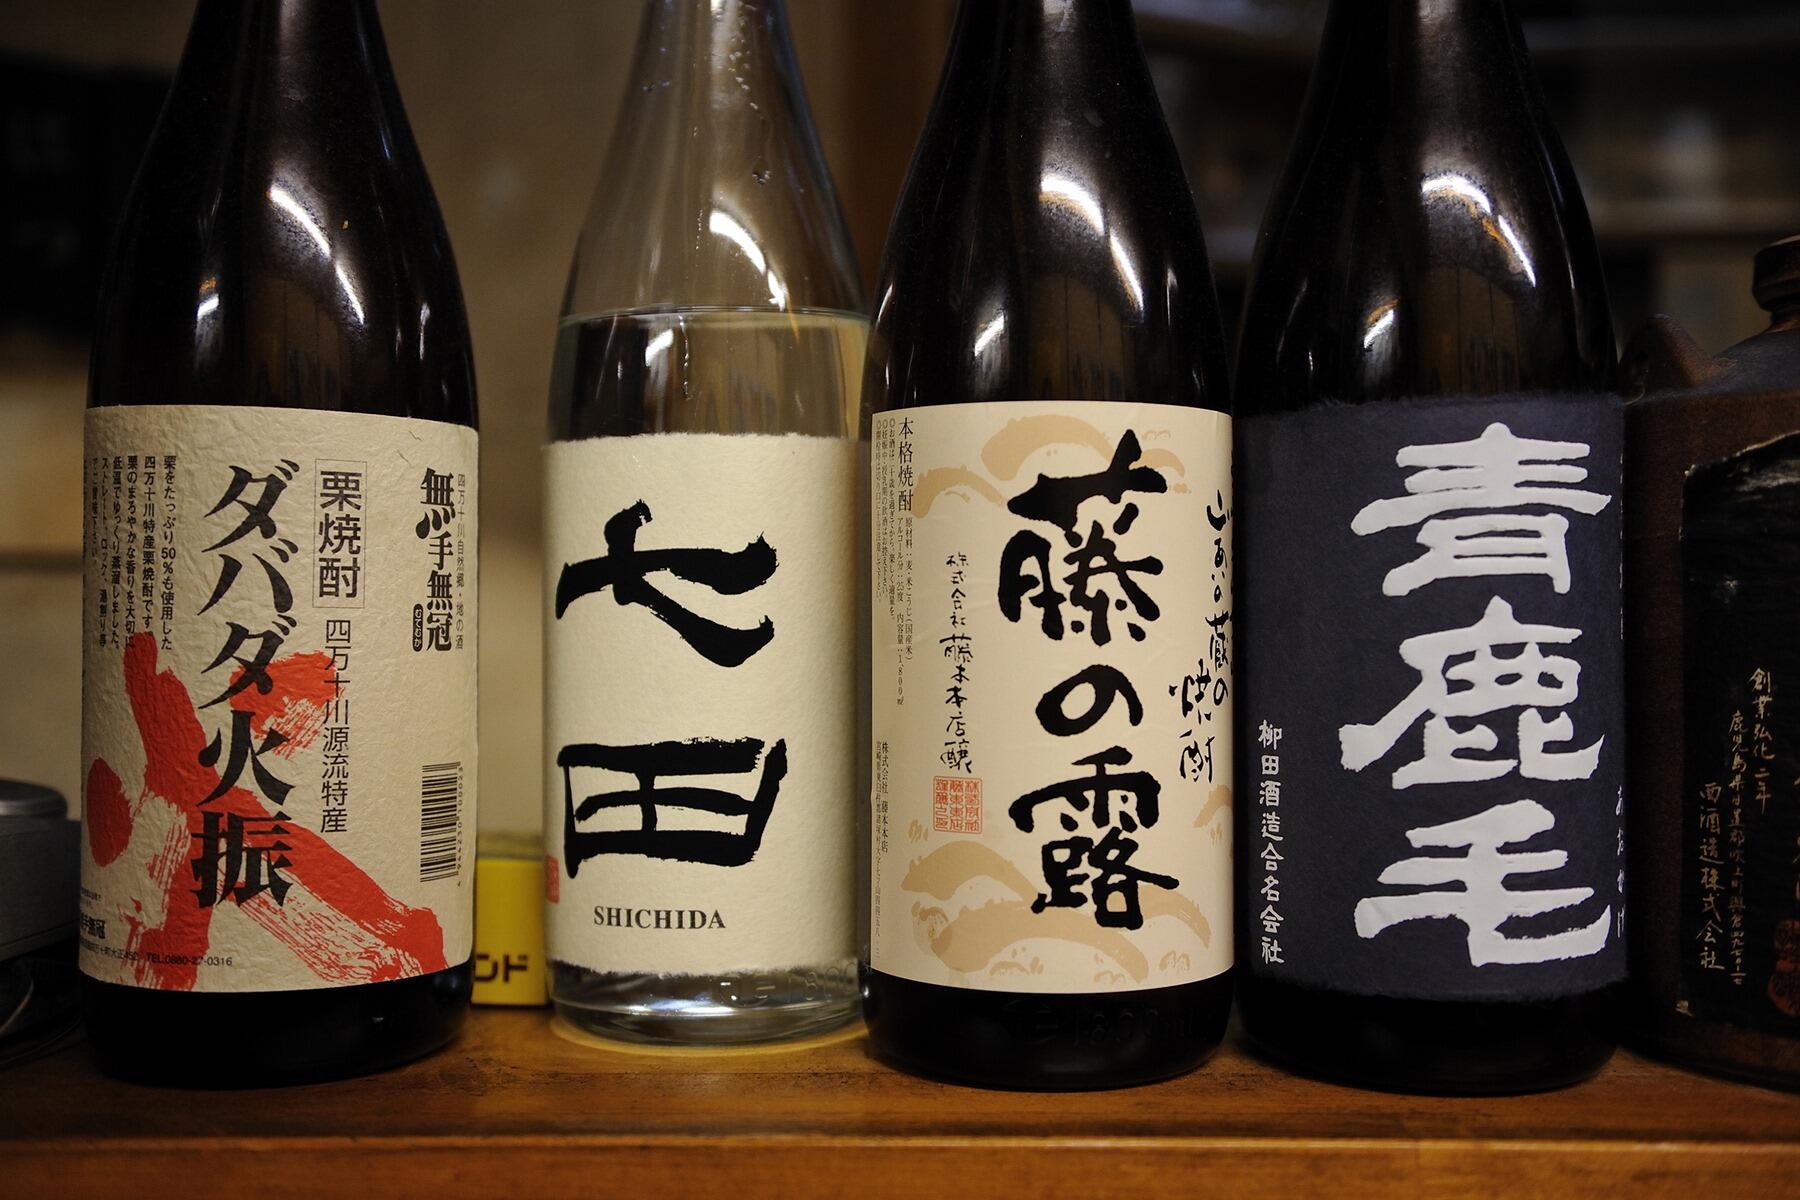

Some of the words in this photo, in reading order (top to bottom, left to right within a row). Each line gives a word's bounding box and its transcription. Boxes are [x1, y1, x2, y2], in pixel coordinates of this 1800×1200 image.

[319, 470, 362, 598] 栗焼酎
[416, 467, 456, 652] 無手無冠
[898, 417, 914, 512] 本格焼酎
[191, 459, 300, 907] ダバダ火振
[320, 619, 352, 834] 四万十川源流特産
[556, 499, 788, 878] 七田
[998, 428, 1180, 931] 藤の露
[1338, 422, 1612, 967] 青鹿毛
[593, 906, 726, 929] SHICHIDA
[1258, 720, 1284, 964] 柳田酒造合名会社
[1696, 782, 1726, 971] 西酒造株式会社
